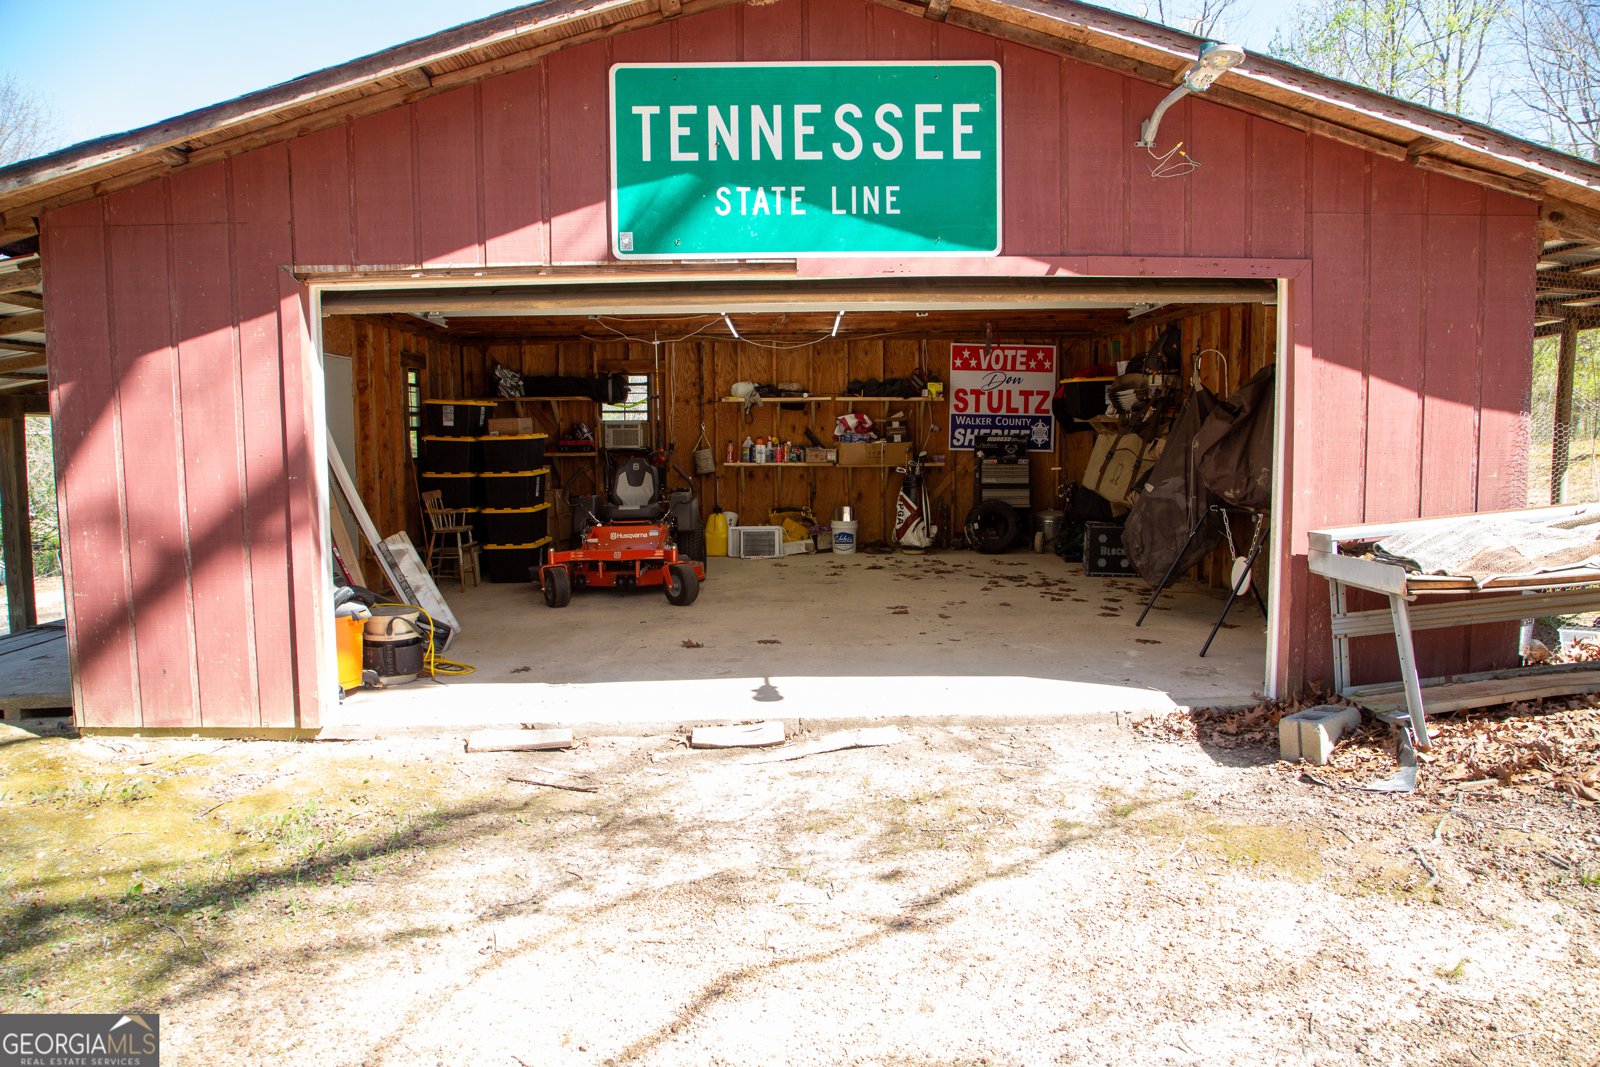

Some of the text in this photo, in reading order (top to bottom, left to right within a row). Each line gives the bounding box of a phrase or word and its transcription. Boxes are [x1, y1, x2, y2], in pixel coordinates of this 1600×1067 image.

[631, 102, 982, 162] TENNESSEE
[714, 185, 901, 216] STATE LINE
[979, 349, 1028, 370] VOTE
[981, 370, 1024, 392] Don
[953, 388, 1051, 415] STULTZ
[955, 415, 1032, 426] WALKER COUNTY
